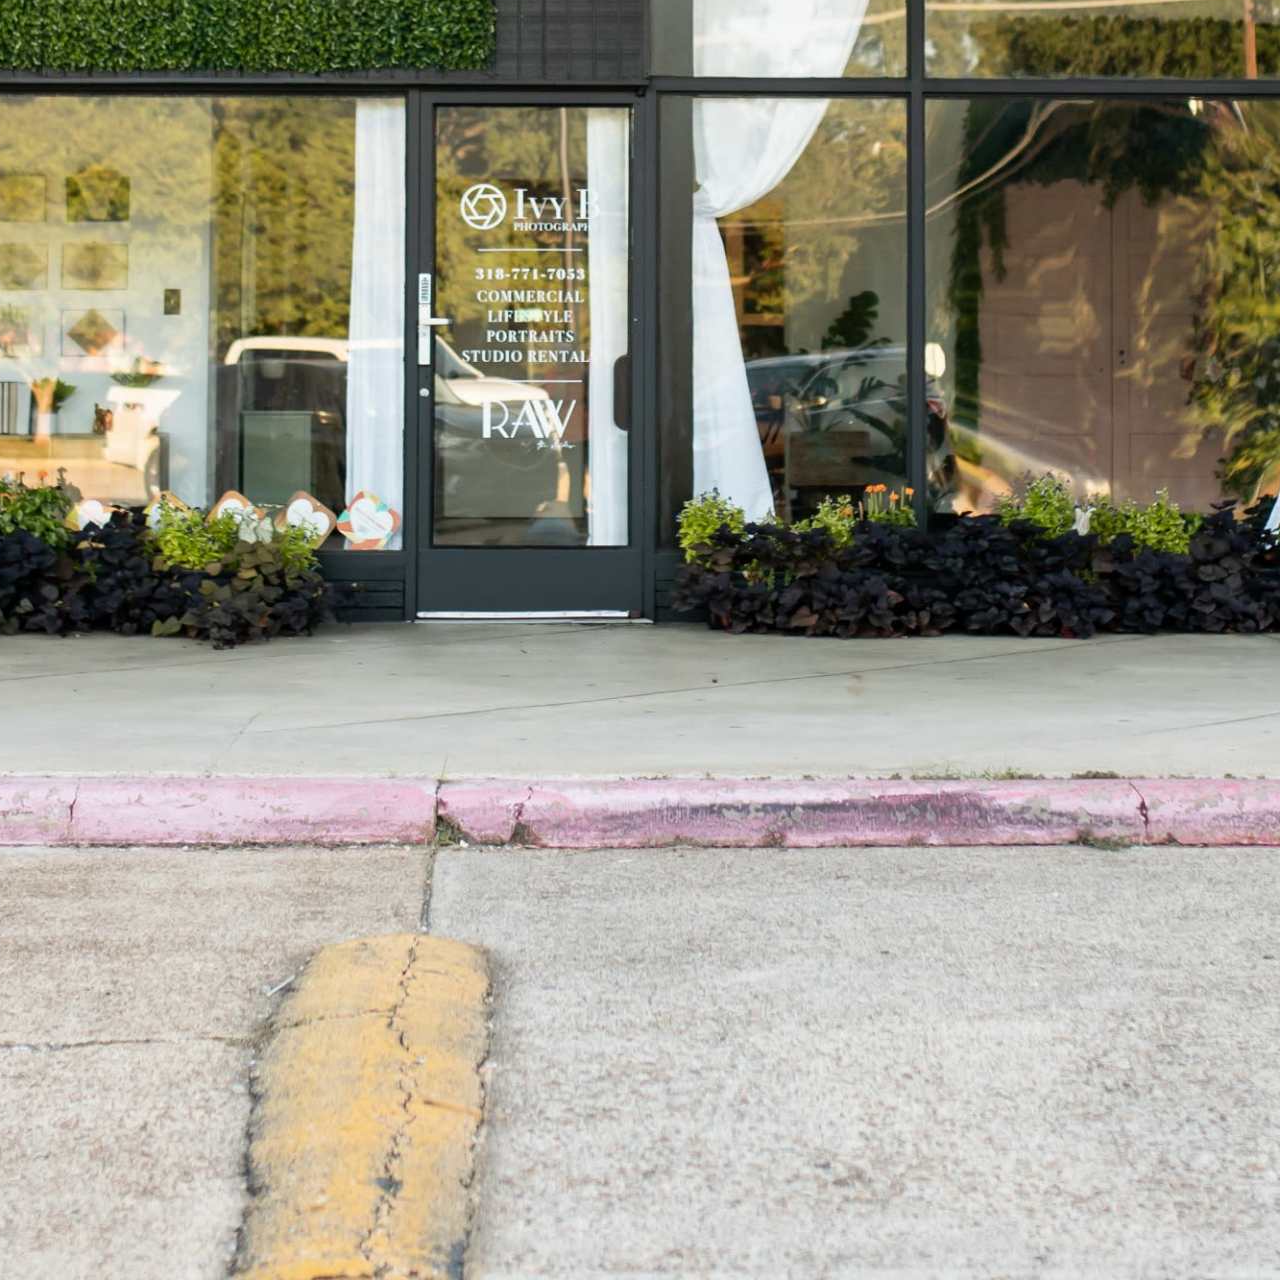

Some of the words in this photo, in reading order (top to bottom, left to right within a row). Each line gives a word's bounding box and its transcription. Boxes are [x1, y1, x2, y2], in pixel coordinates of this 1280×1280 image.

[576, 188, 601, 220] B
[475, 267, 586, 280] 318-771-7053
[476, 289, 585, 303] COMMERCIAL
[486, 329, 575, 343] PORTRAITS
[461, 349, 523, 363] STUDIO
[482, 399, 577, 439] RAW
